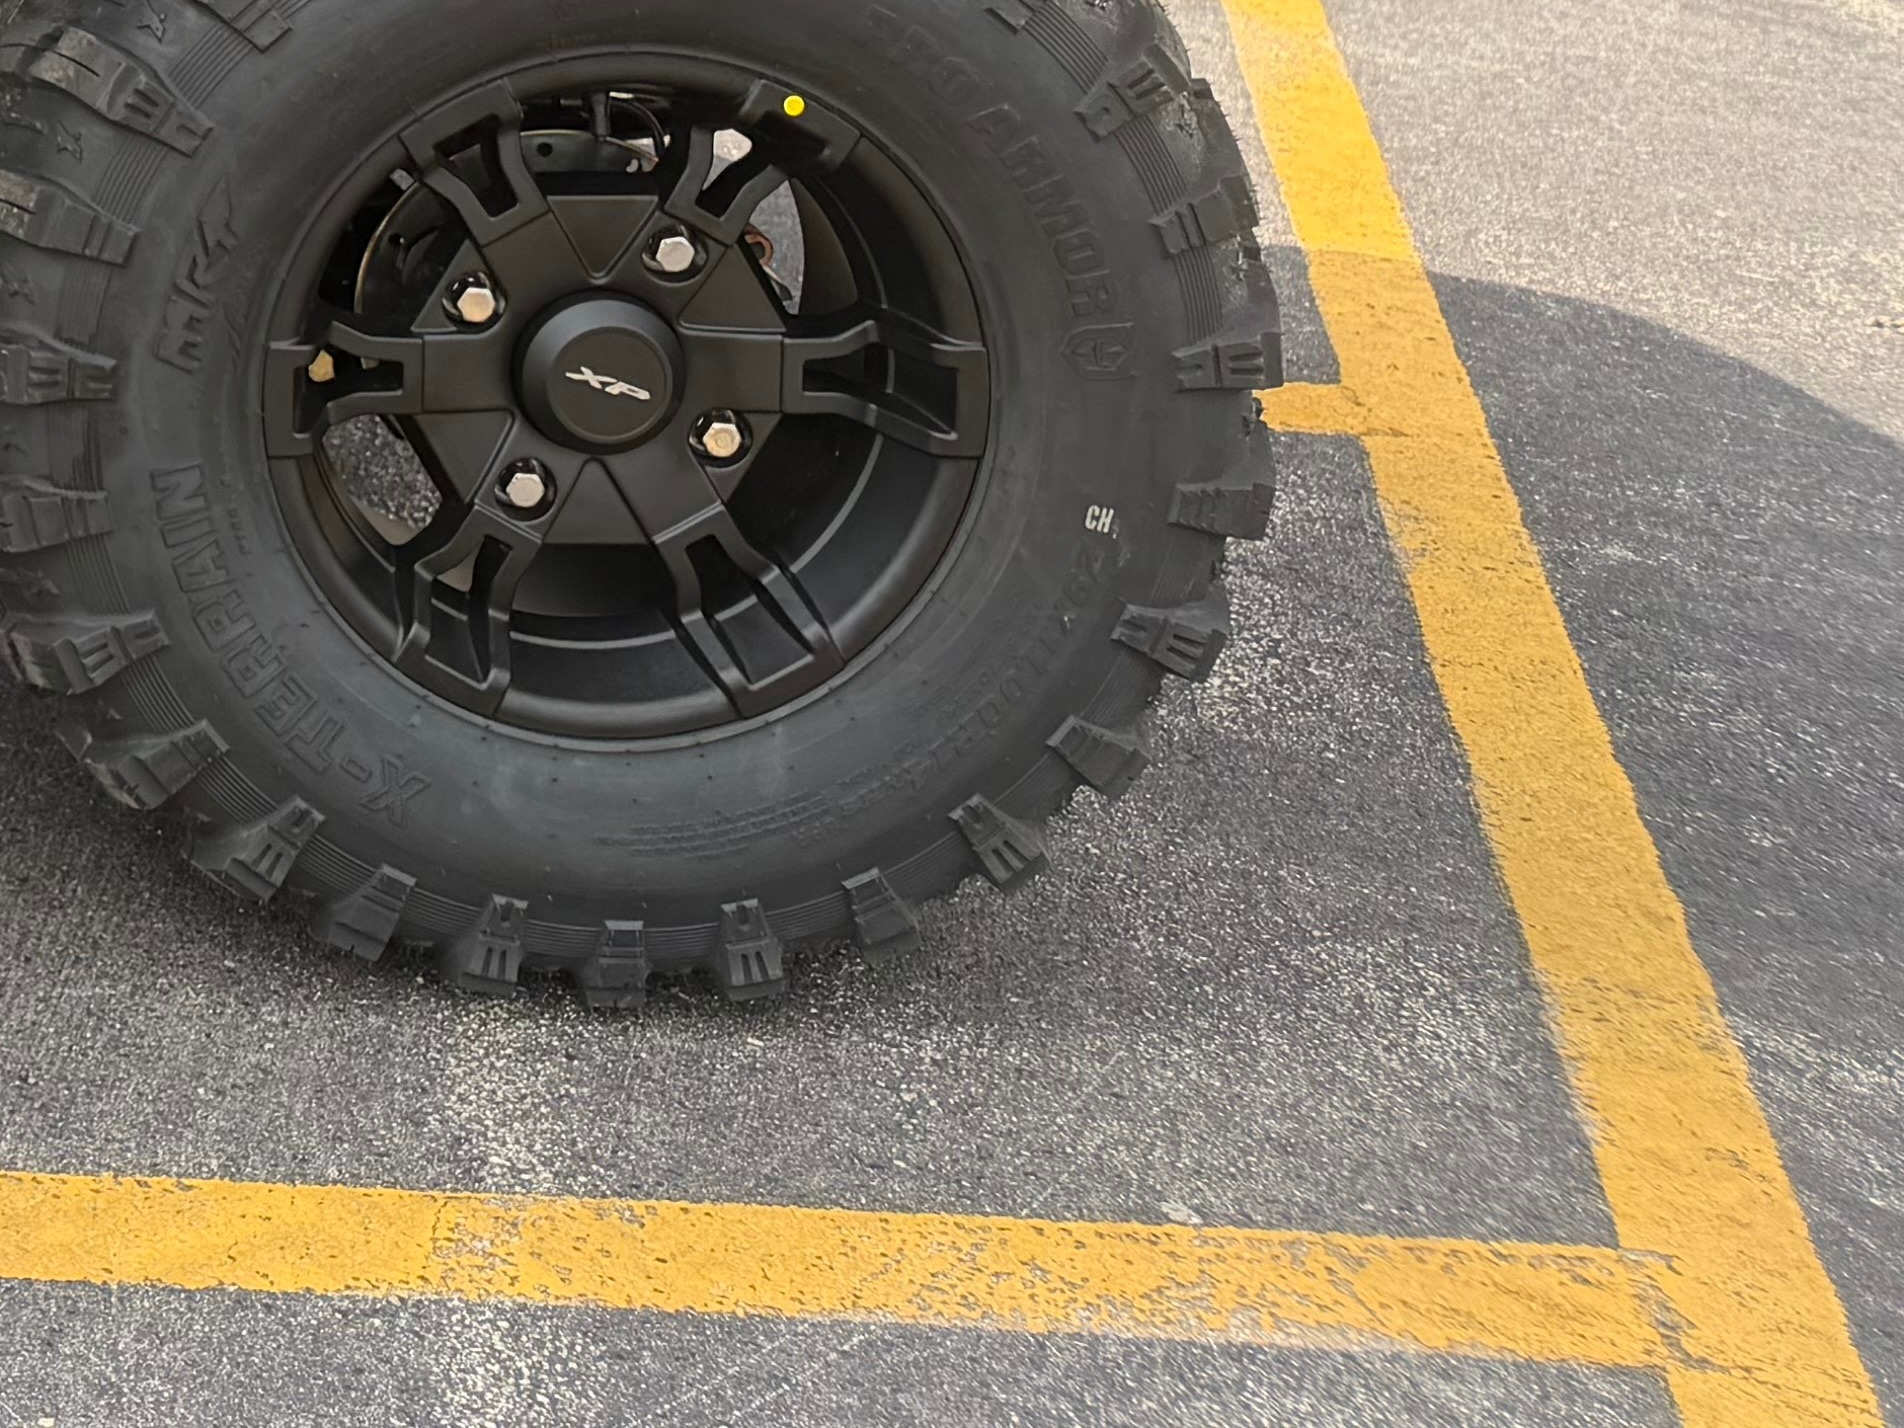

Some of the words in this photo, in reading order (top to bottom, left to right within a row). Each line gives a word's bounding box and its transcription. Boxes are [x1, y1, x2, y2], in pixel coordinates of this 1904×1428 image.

[970, 100, 1115, 333] ARMOR
[565, 366, 651, 400] XP
[1085, 505, 1114, 533] CH
[150, 462, 432, 826] X-TERRAIN
